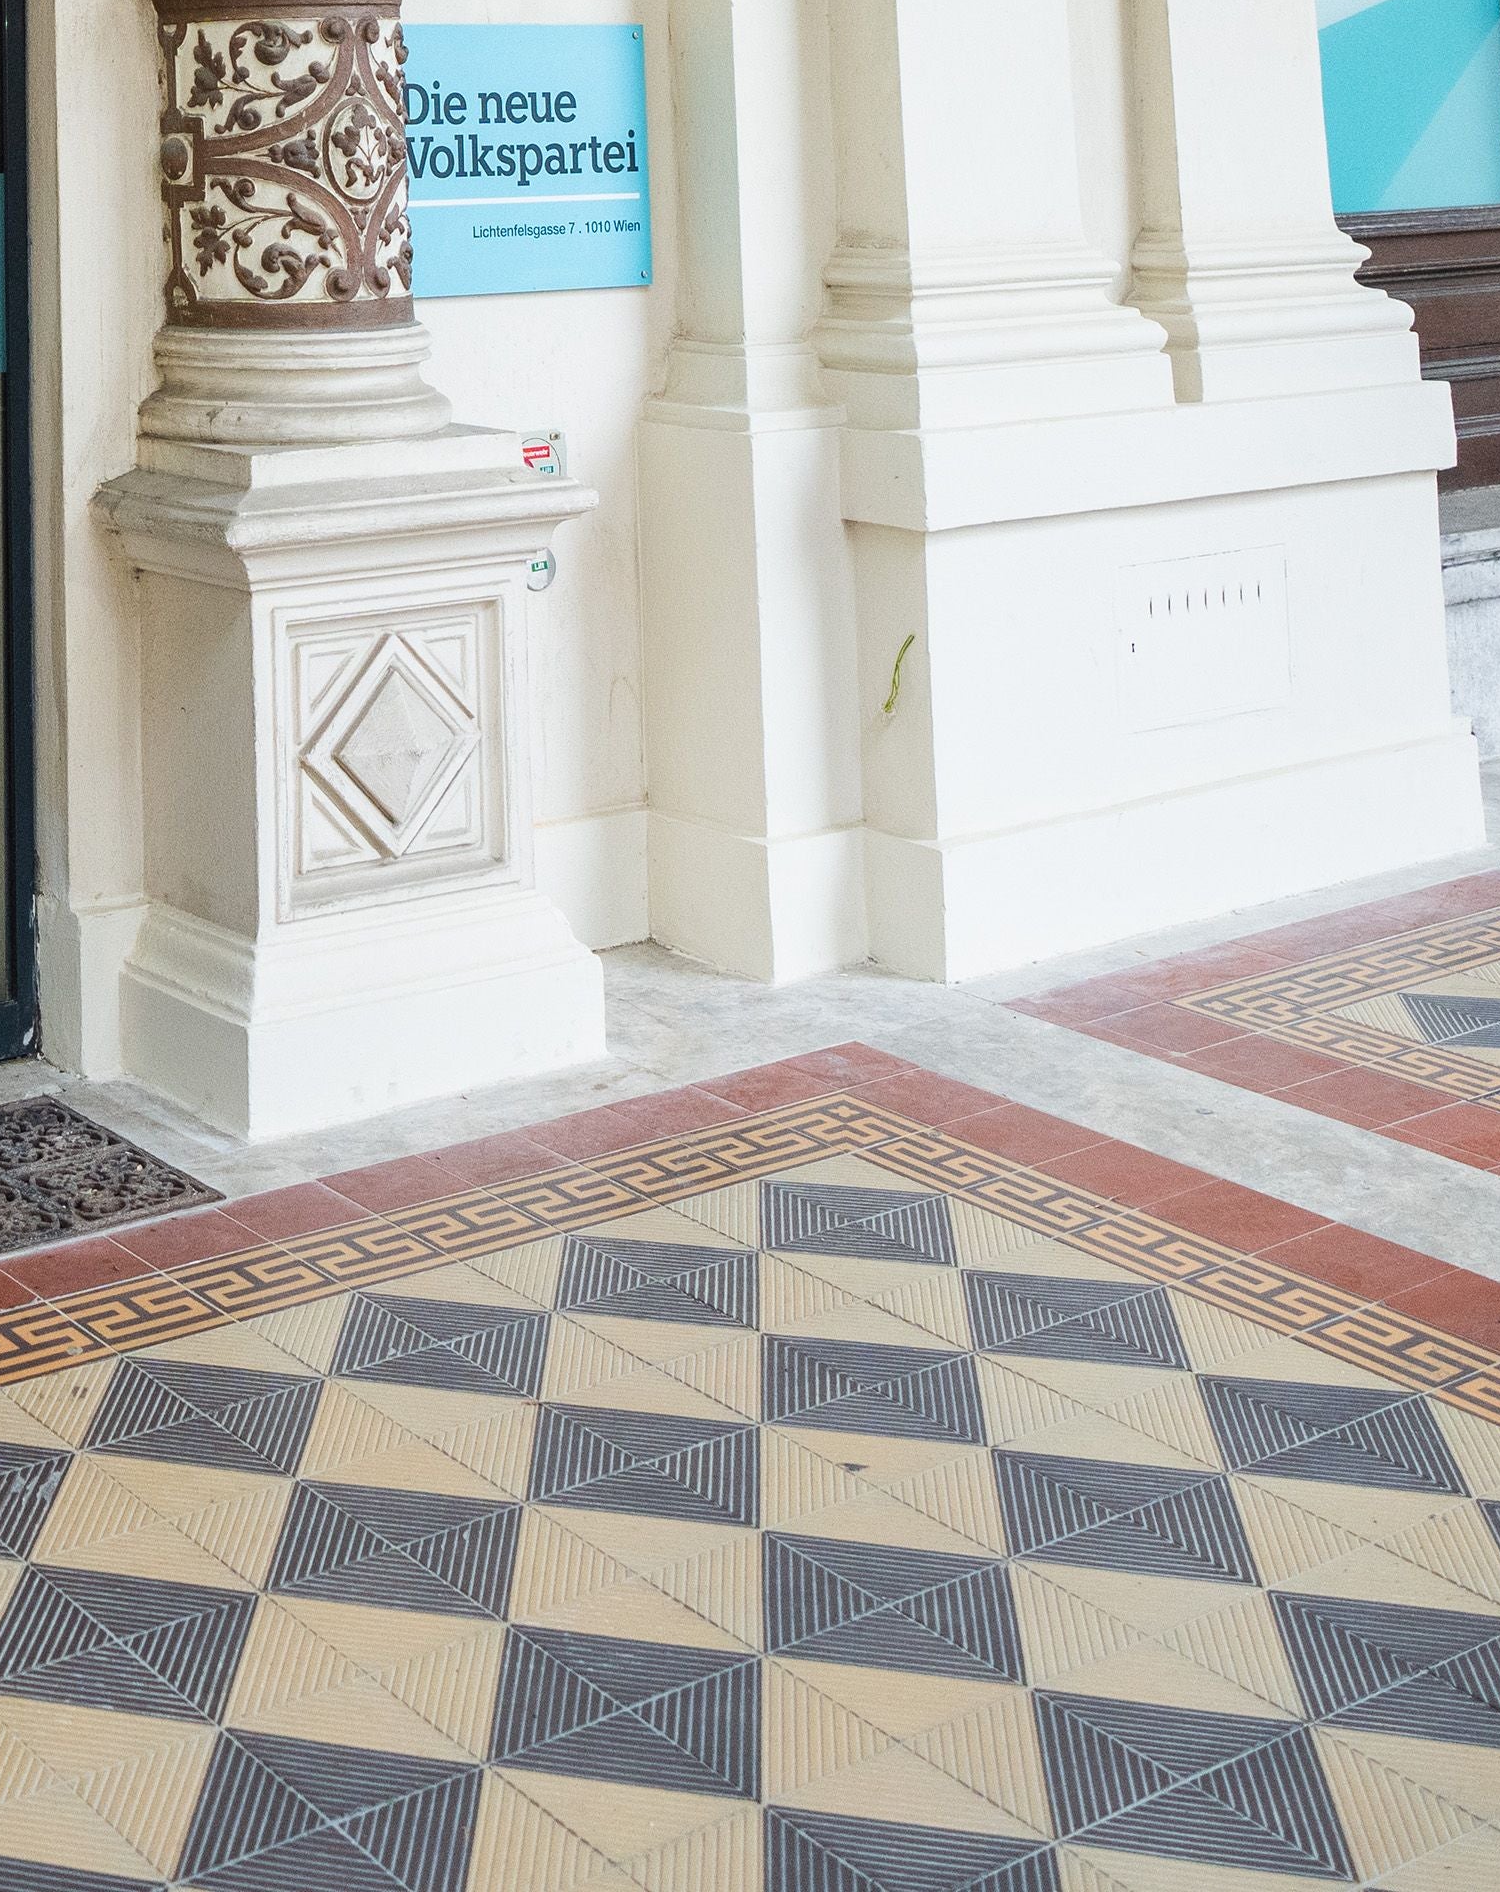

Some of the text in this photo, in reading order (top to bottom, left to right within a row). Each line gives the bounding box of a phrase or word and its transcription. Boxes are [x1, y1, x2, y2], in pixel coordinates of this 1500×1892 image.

[404, 80, 577, 126] Die neue
[405, 129, 638, 186] Volkspartei
[473, 222, 565, 240] Lichtenfelsgasse
[569, 222, 574, 233] 7
[585, 220, 610, 234] 1010
[613, 220, 640, 232] Wien
